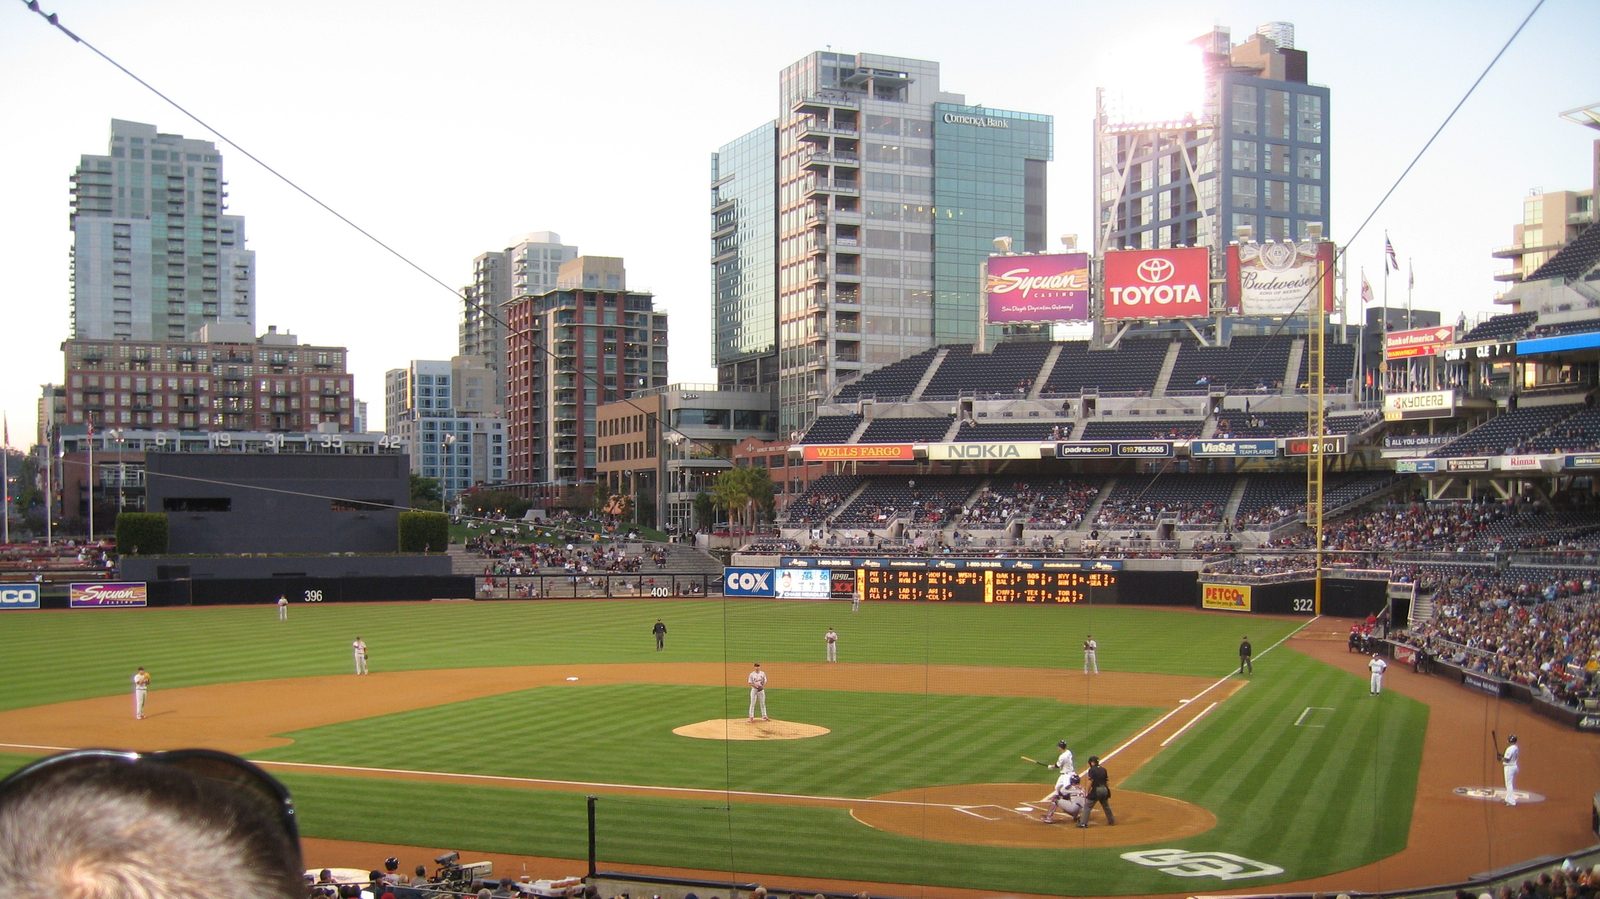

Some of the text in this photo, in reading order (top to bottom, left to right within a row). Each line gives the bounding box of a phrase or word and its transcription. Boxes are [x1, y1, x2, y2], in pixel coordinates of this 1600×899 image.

[987, 118, 1008, 128] Bank
[992, 268, 1081, 298] Sycuan
[1241, 270, 1317, 290] Budweiser
[1110, 284, 1202, 306] TOYOTA
[1388, 334, 1434, 346] Bank of America
[1461, 349, 1466, 359] 3
[1476, 346, 1489, 358] CLE
[1495, 345, 1500, 355] 7
[1402, 394, 1443, 408] KYOCERA
[155, 434, 166, 446] 6
[212, 434, 232, 447] 19
[265, 434, 285, 447] 31
[320, 435, 342, 448] 35
[378, 435, 401, 449] 42
[816, 447, 901, 457] WELLS FARGO
[948, 445, 1020, 458] NOKIA
[1064, 446, 1110, 454] padres.com
[1201, 442, 1235, 453] ViaSat
[1510, 457, 1536, 466] Rinnai
[728, 572, 770, 592] COX
[0, 590, 36, 603] CO
[80, 586, 138, 604] Sycuan
[305, 590, 322, 602] 396
[651, 587, 668, 597] 400
[1206, 588, 1238, 601] PETCO
[1293, 599, 1313, 611] 322
